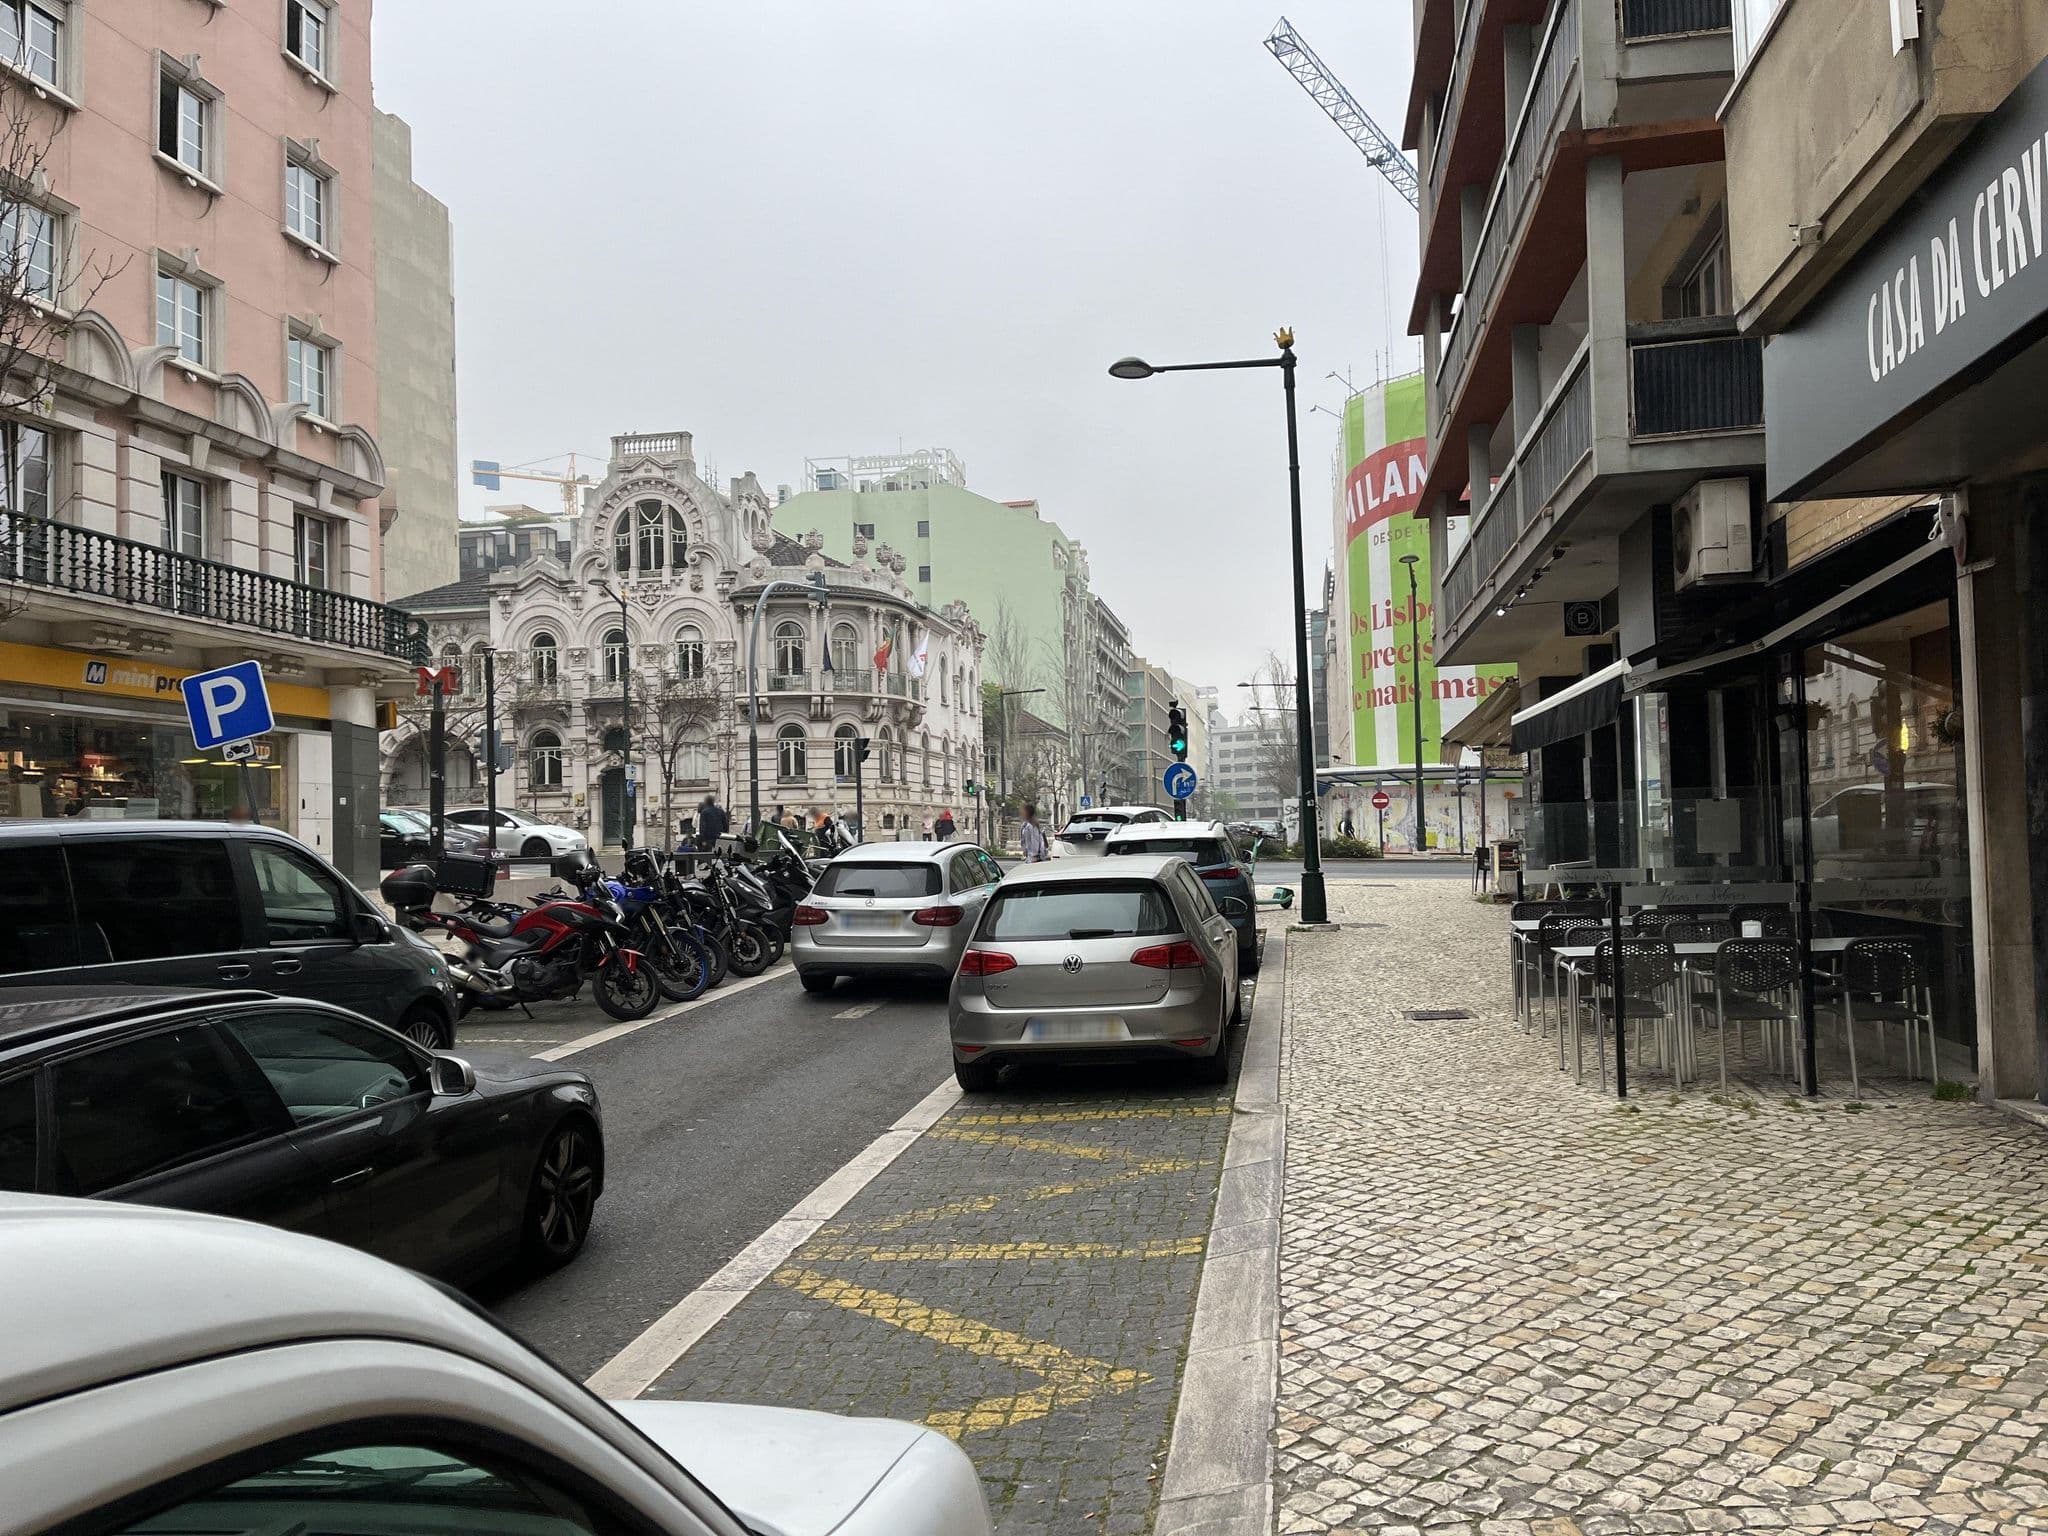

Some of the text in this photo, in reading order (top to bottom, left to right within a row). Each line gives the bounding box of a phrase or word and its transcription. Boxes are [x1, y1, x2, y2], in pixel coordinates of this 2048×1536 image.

[1868, 255, 1925, 382] CASA
[1931, 217, 1966, 335] DA
[1374, 527, 1412, 546] DESDE
[200, 676, 246, 738] P
